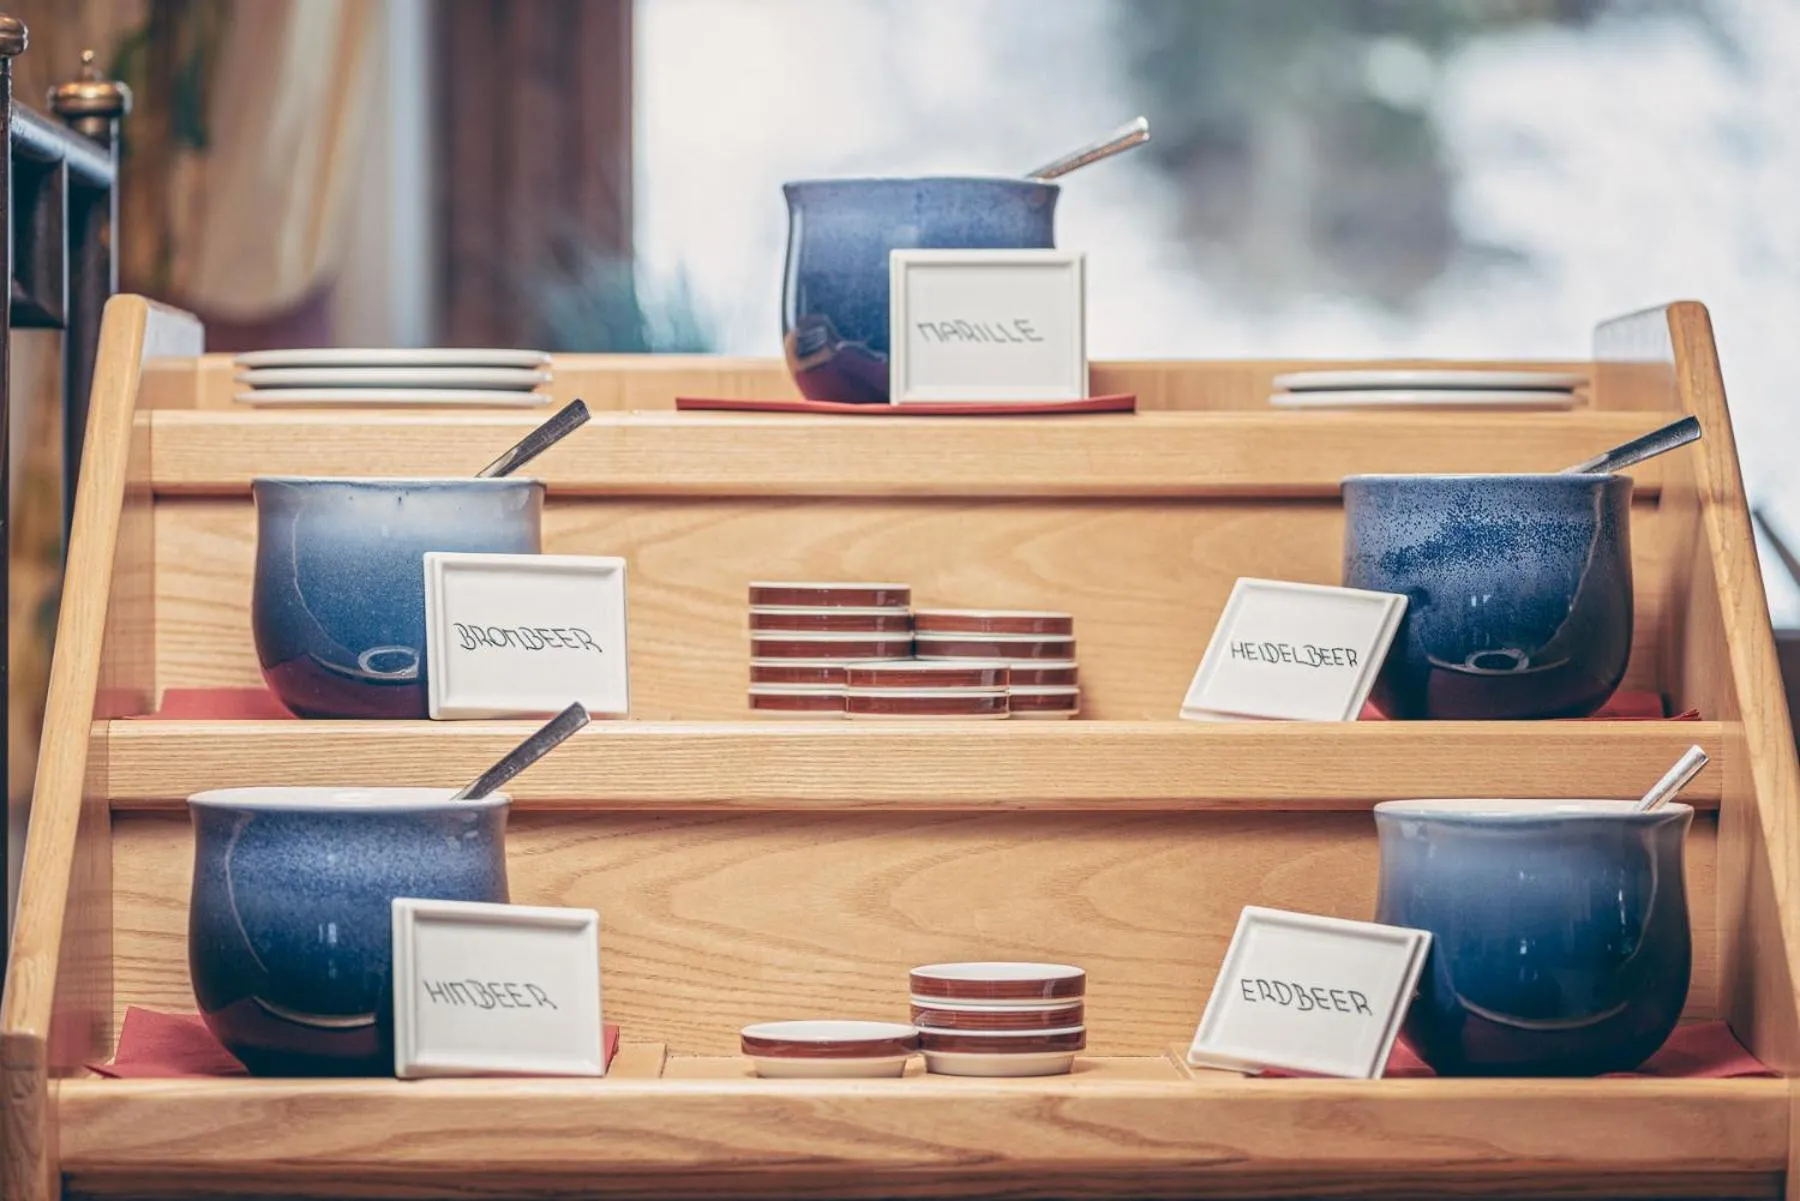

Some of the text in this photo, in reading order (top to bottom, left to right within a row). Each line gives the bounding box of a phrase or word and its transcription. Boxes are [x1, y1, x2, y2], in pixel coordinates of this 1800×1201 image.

[917, 319, 1044, 343] MARILLE
[453, 622, 603, 653] BROMBEER
[1231, 642, 1358, 668] HEIDELBEER
[422, 979, 558, 1010] HIMBEER
[1240, 979, 1373, 1016] ERDBEER
